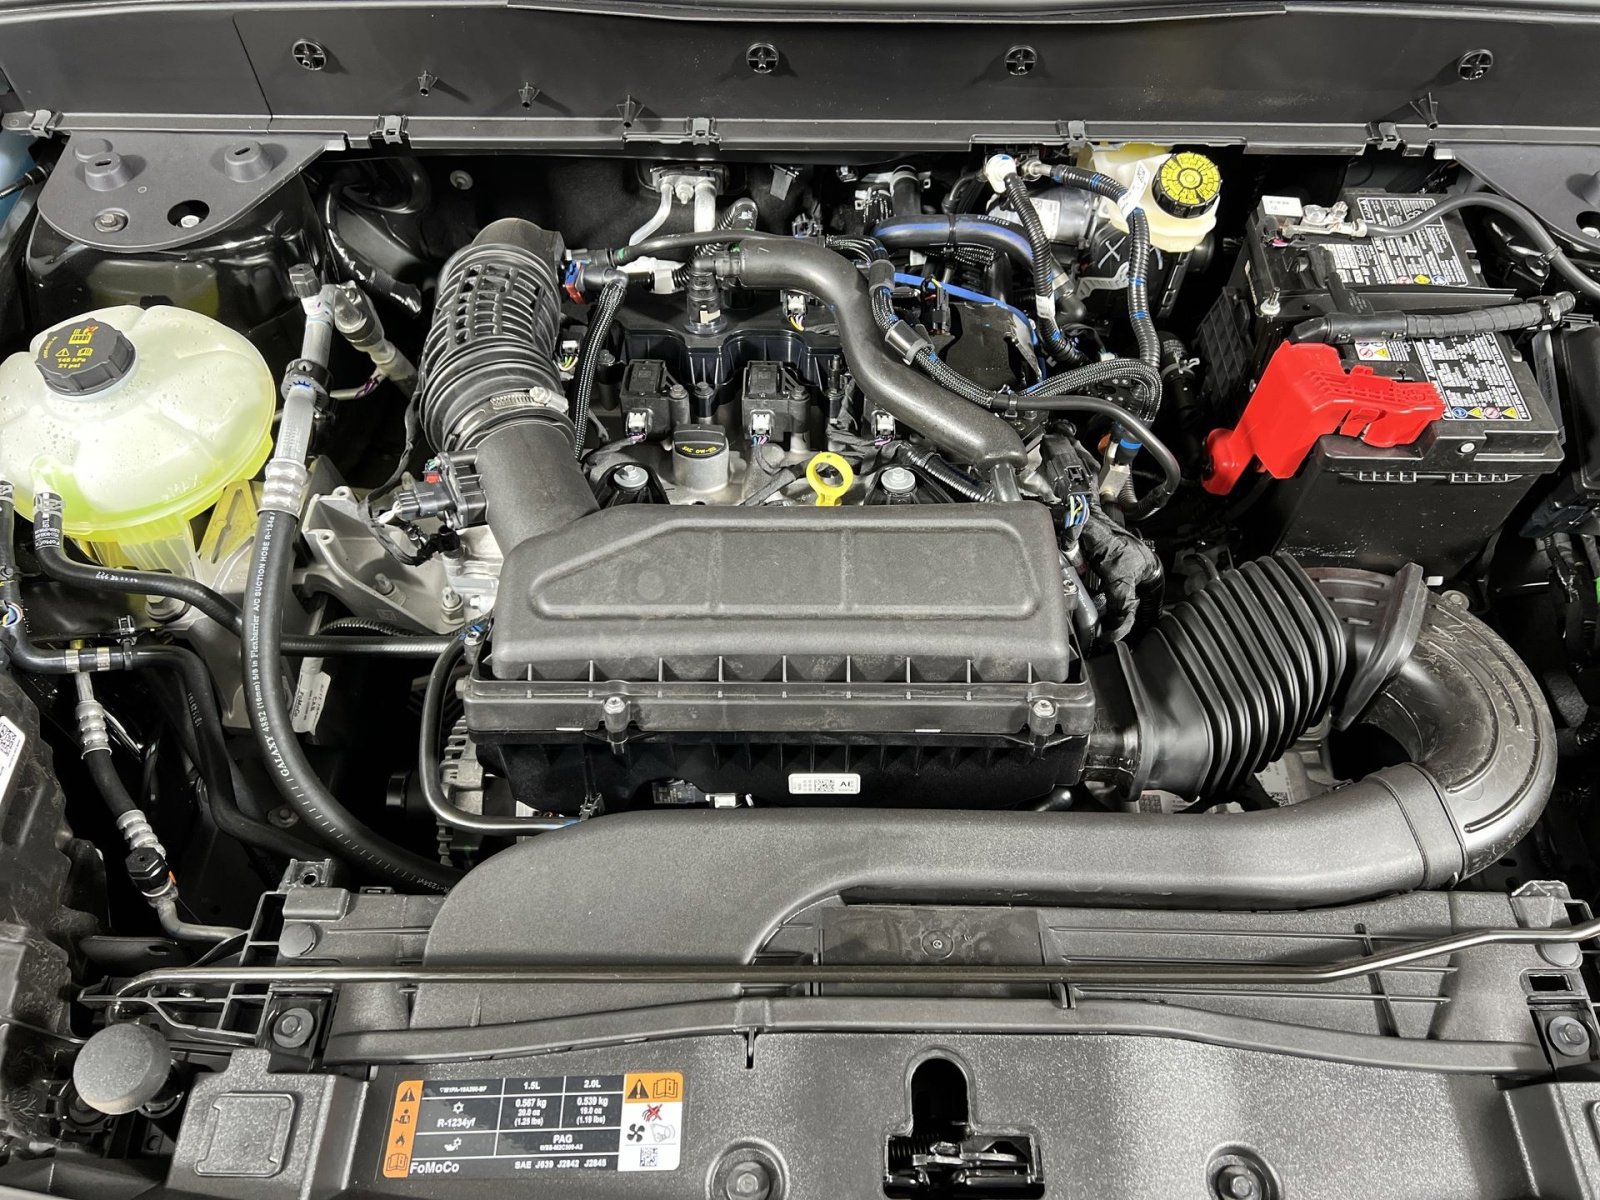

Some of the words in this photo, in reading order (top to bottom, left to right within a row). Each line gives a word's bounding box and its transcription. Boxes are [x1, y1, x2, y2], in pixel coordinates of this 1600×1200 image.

[264, 515, 276, 540] R-134a
[261, 541, 271, 562] HOSE
[254, 562, 266, 597] SUCTION
[253, 598, 261, 612] A/C
[250, 614, 260, 658] Flexbarrier
[253, 681, 264, 709] (16mm)
[258, 711, 270, 732] 4882
[264, 735, 290, 777] GALAXY
[523, 1081, 541, 1090] 1.5L
[583, 1080, 601, 1089] 2.0L
[515, 1099, 537, 1108] 0.567
[537, 1098, 547, 1109] kg
[576, 1096, 598, 1106] 0.539
[598, 1096, 609, 1107] kg
[436, 1117, 476, 1129] R-1234yf
[531, 1117, 544, 1127] lbs)
[592, 1115, 606, 1125] lbs)
[553, 1134, 573, 1144] PAG
[409, 1160, 460, 1174] FoMoCo
[514, 1160, 532, 1169] SAE
[535, 1160, 554, 1169] J639
